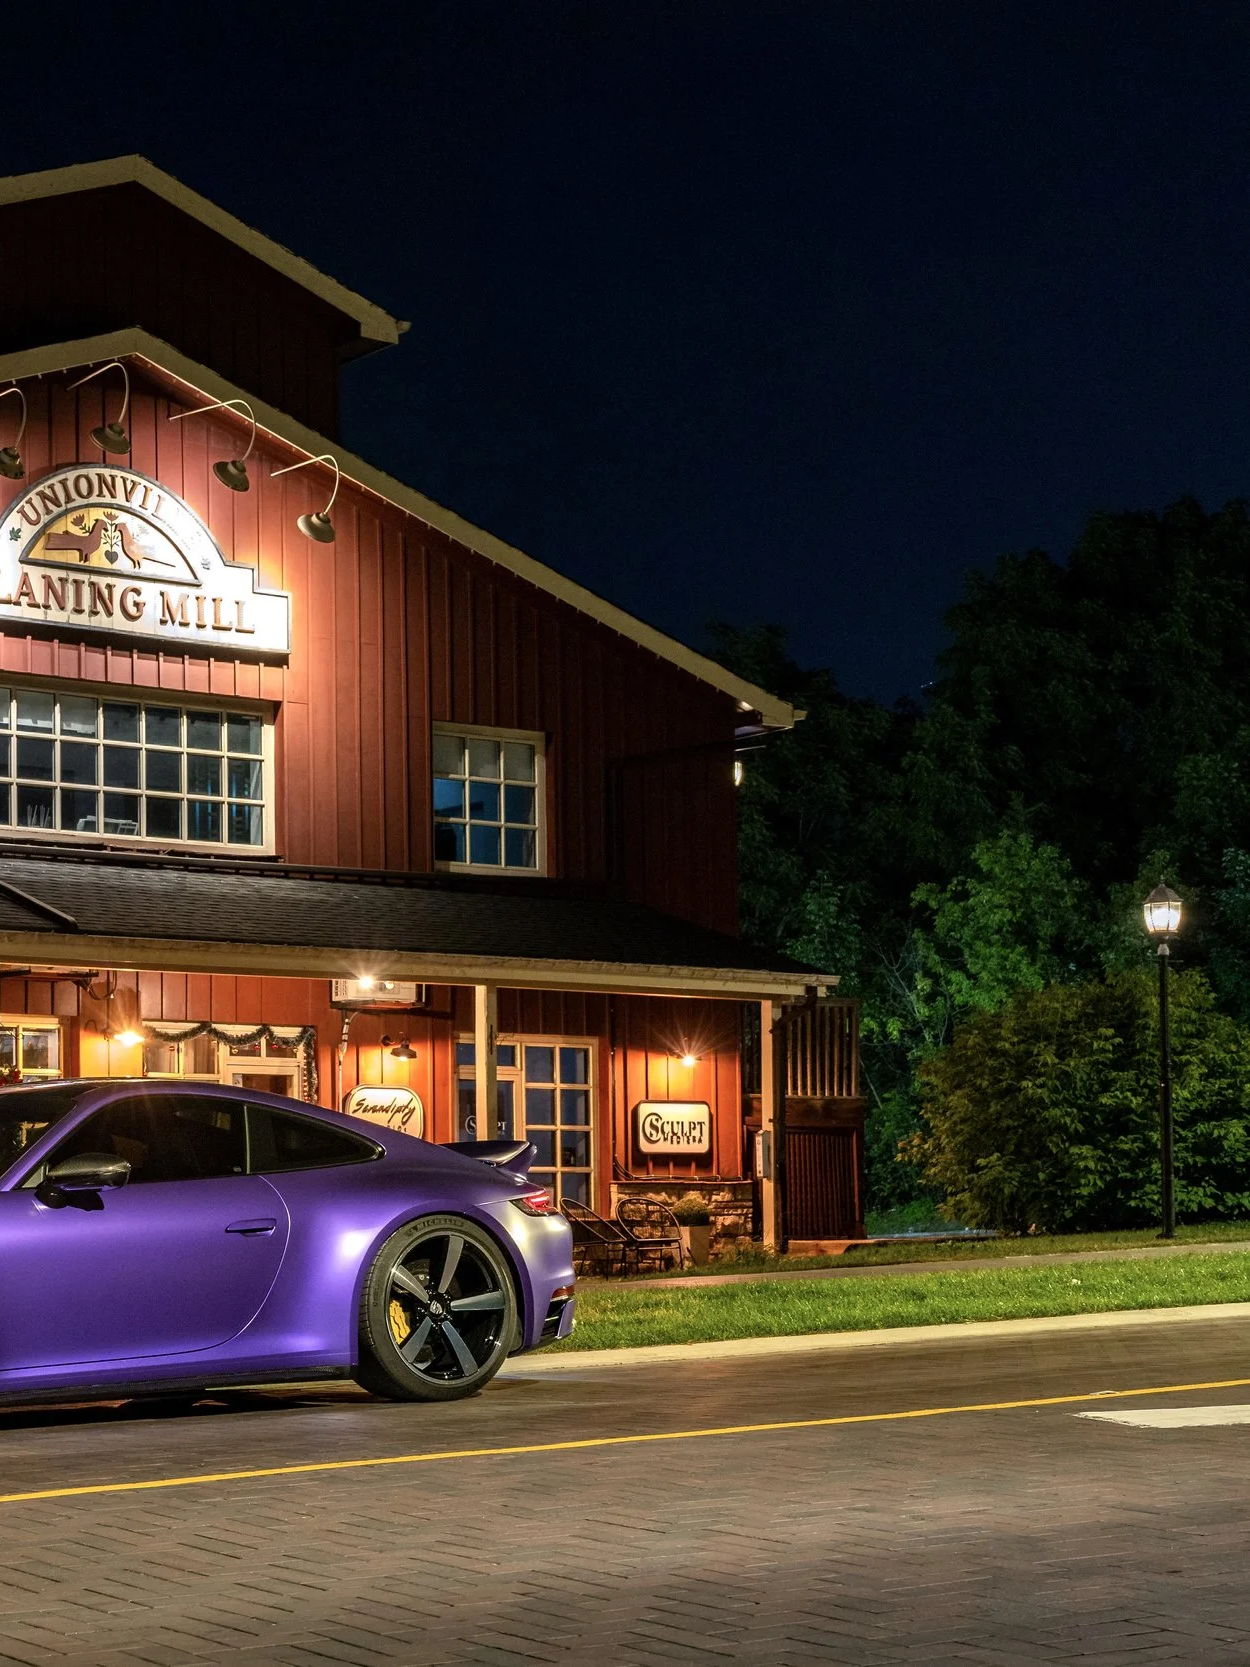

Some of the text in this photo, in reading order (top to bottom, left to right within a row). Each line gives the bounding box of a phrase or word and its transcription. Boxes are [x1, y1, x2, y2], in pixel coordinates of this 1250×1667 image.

[17, 472, 180, 536] UNIONVIL
[159, 589, 256, 634] MILL
[643, 1114, 706, 1140] SCULPT
